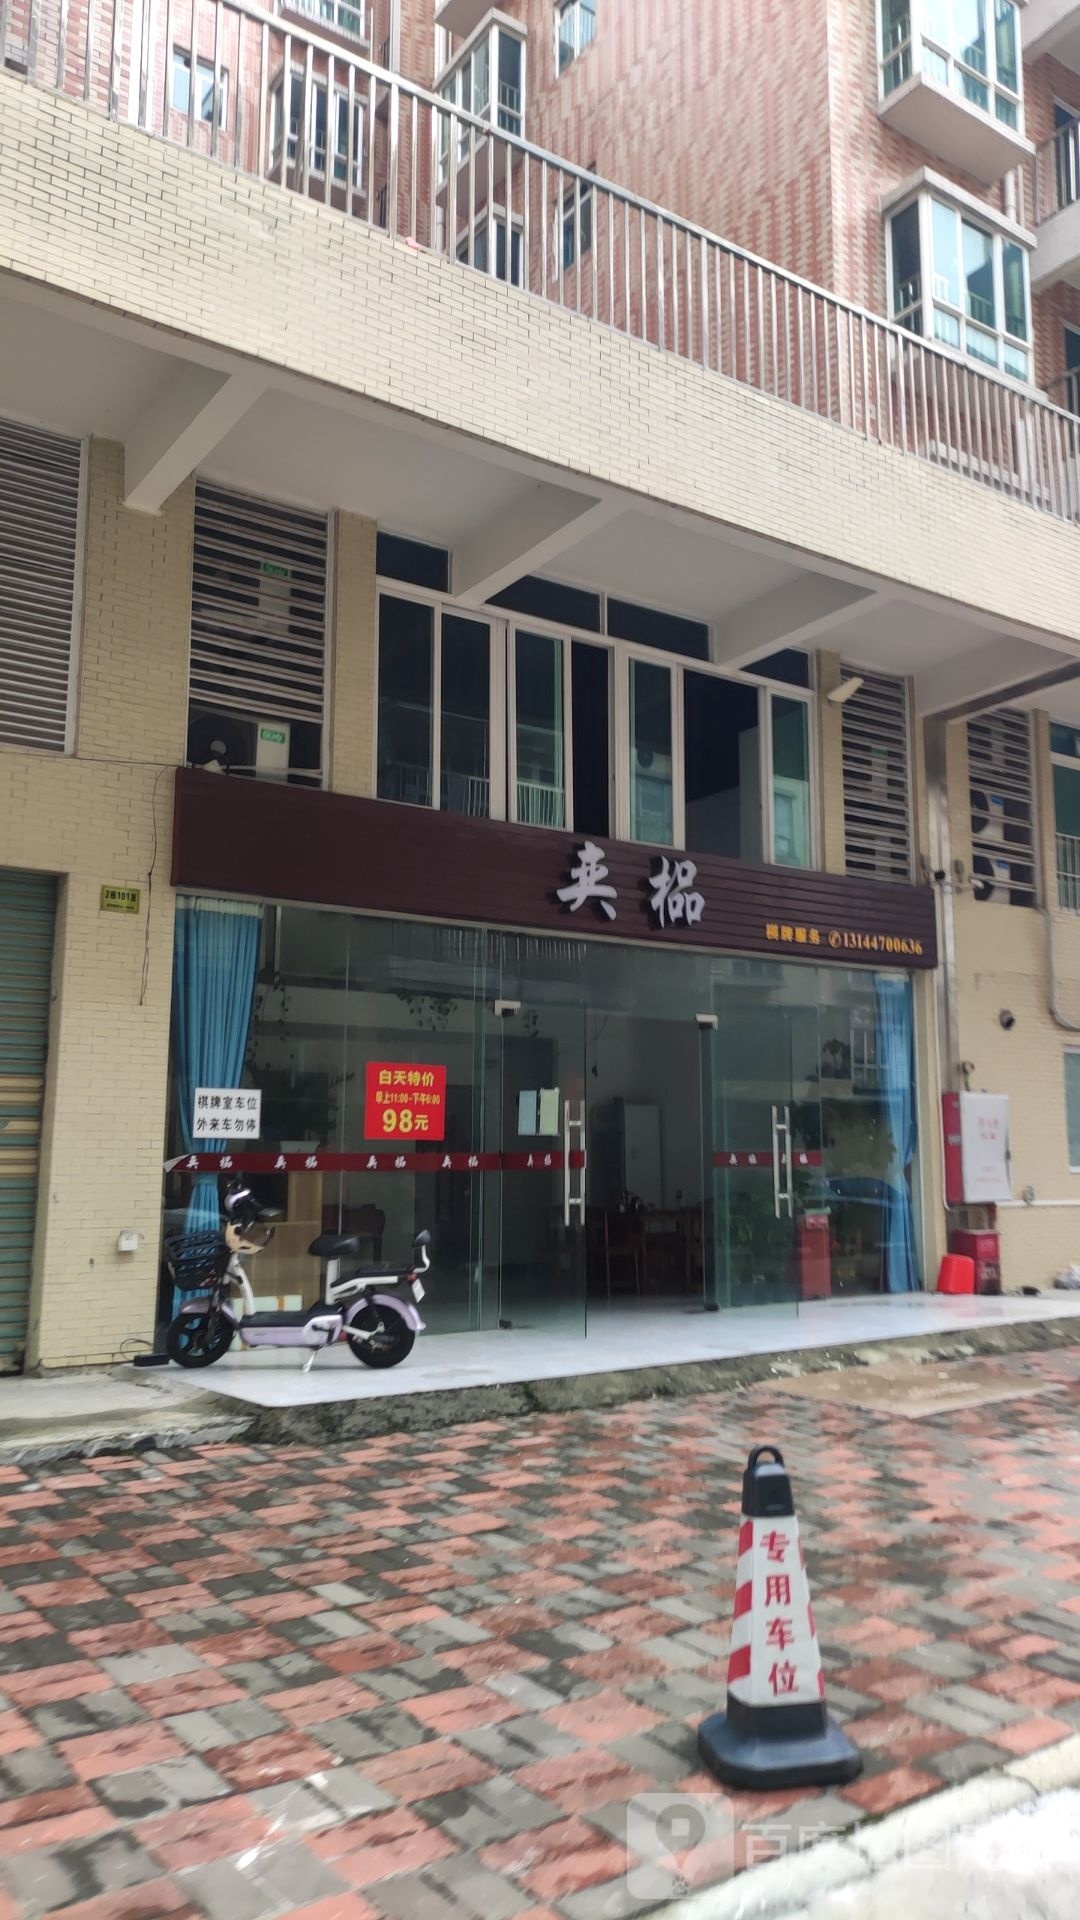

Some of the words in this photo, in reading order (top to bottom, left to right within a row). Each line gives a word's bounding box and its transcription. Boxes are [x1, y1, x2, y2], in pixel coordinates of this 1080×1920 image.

[844, 933, 922, 955] 13144700636
[379, 1069, 434, 1087] 白天特价
[197, 1095, 257, 1110] 棋牌室车位
[196, 1117, 256, 1132] 外来车勿停
[383, 1108, 429, 1133] 98元
[760, 1531, 799, 1696] 专用车位
